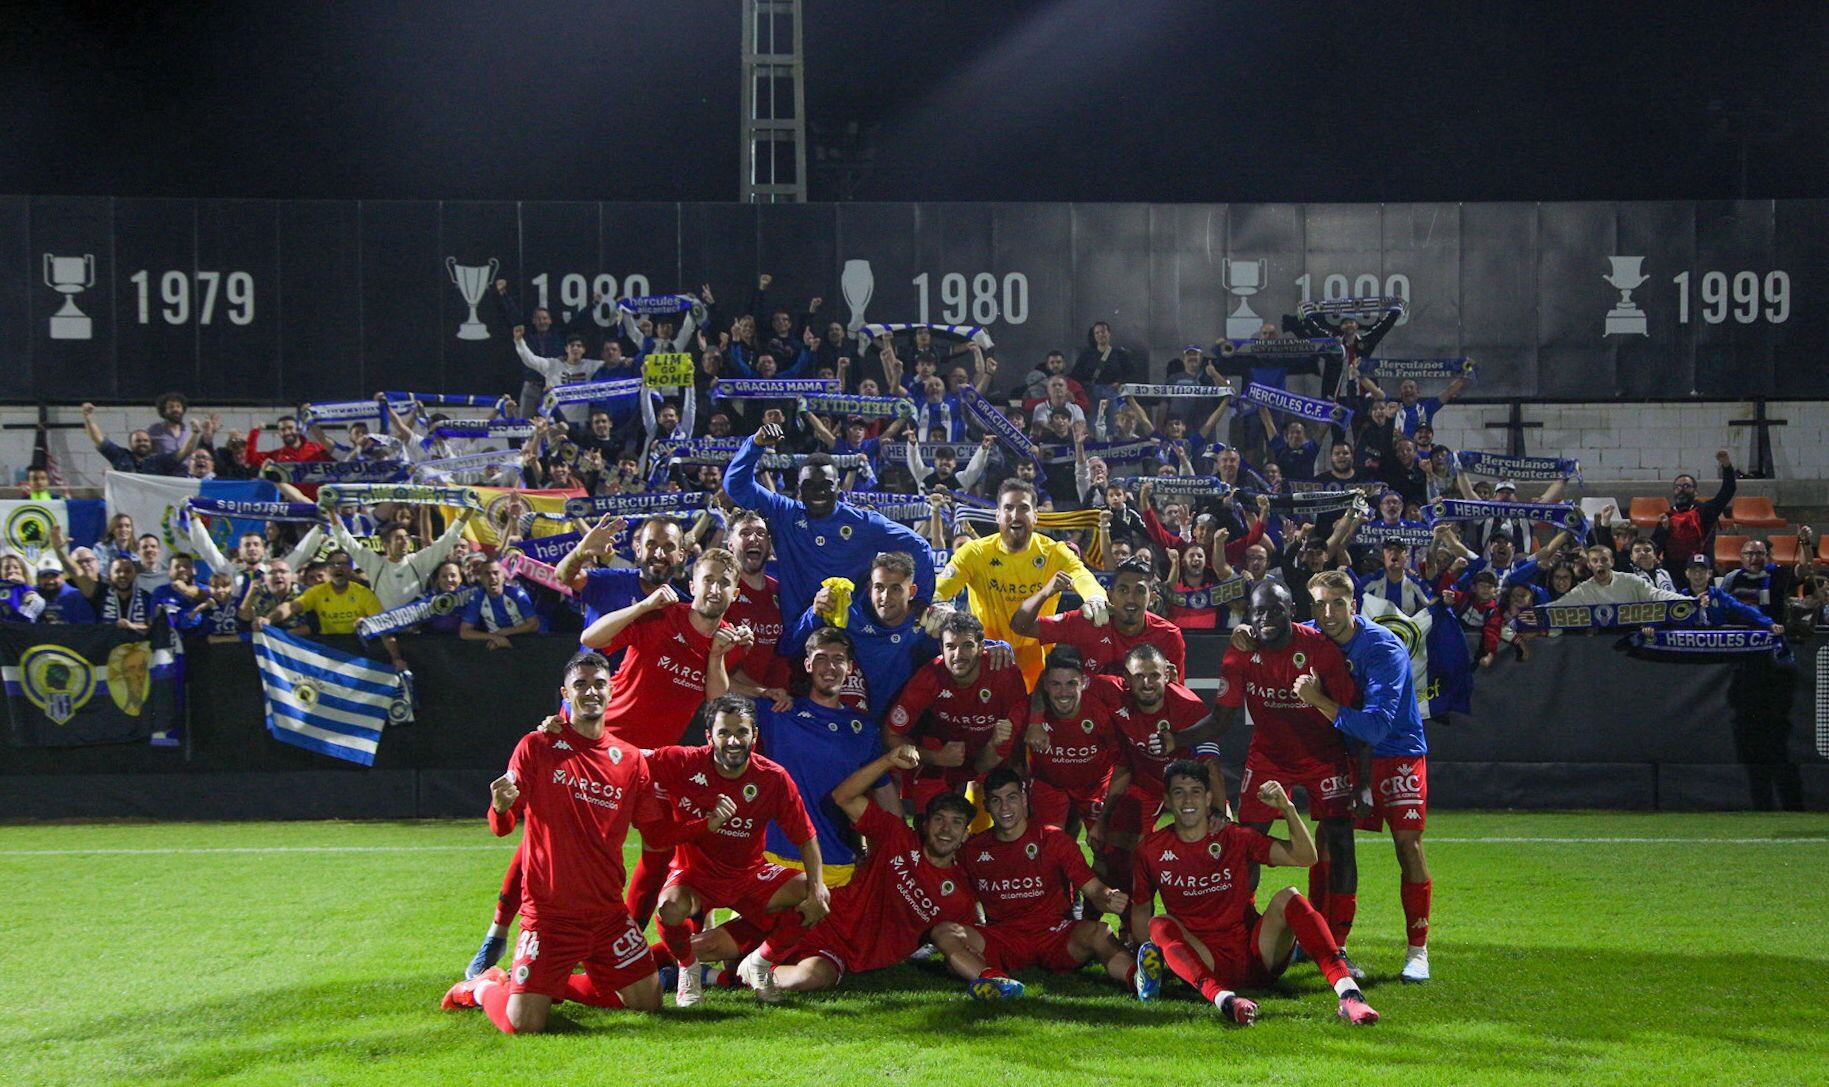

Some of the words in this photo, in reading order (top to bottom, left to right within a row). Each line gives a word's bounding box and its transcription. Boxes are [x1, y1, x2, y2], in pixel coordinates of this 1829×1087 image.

[130, 270, 254, 325] 1979
[912, 272, 1029, 325] 1980
[1672, 270, 1791, 324] 1999
[653, 354, 682, 366] LIM
[661, 365, 677, 374] GO
[1378, 359, 1444, 370] Herculanos
[648, 374, 692, 385] HOME
[735, 381, 785, 392] GRACIAS
[1249, 386, 1302, 412] HERCULES
[976, 399, 1014, 439] GRACIAS
[1474, 463, 1498, 476] Sin
[1501, 465, 1563, 480] Fronteras
[1481, 454, 1556, 470] Herculanos
[1454, 504, 1526, 519] HERCULES
[989, 579, 1043, 594] MARCOS
[1549, 606, 1592, 628] 1922
[1617, 602, 1668, 626] 2022
[1666, 633, 1746, 648] HERCULES
[1246, 681, 1303, 700] MARCO
[552, 769, 623, 800] MARCOS
[1379, 774, 1421, 794] CRC
[574, 791, 619, 811] automoción
[890, 855, 941, 917] MARCOS
[978, 875, 1044, 892] MARCOS
[1160, 868, 1233, 888] MARCOS
[1182, 882, 1233, 897] automoción
[896, 883, 931, 924] automoción
